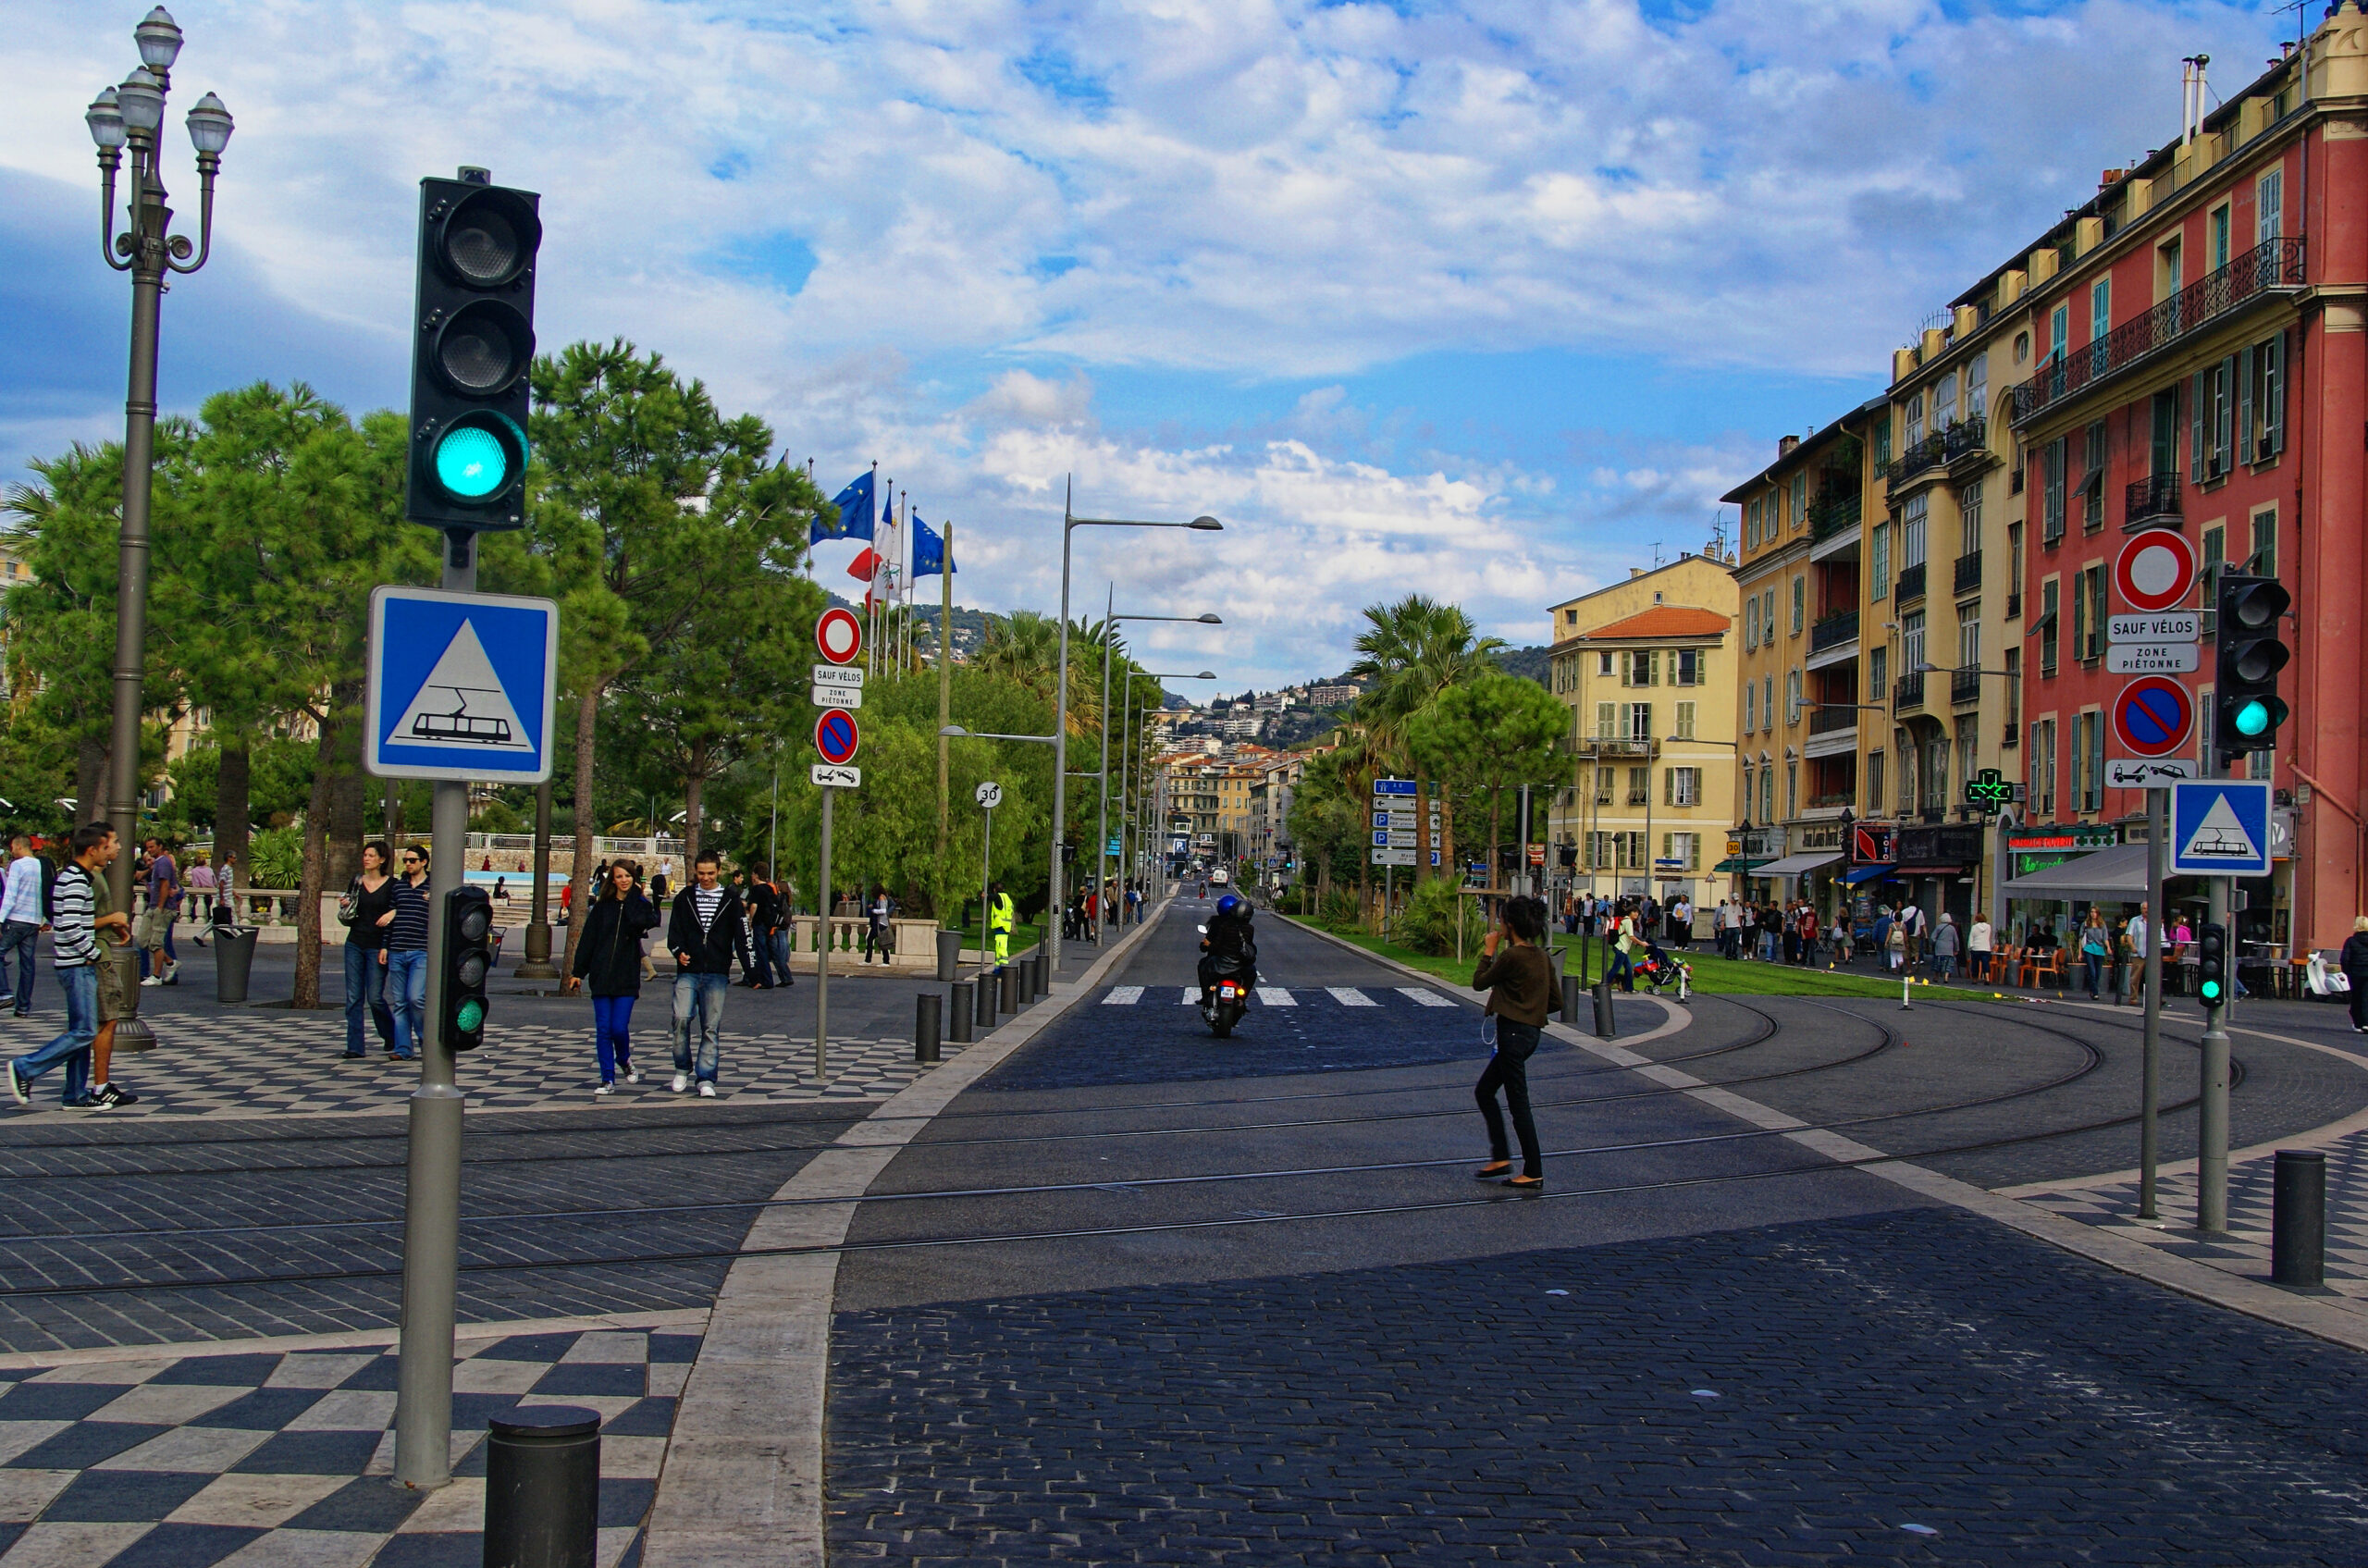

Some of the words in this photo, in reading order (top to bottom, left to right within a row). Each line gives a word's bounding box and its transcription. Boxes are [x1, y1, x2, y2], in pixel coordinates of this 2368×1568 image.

[2114, 622, 2146, 636] SAUF
[2152, 619, 2193, 635] VÉLOS
[2136, 648, 2167, 657] ZONE
[2122, 658, 2182, 669] PIÉTONNE
[818, 671, 836, 680] SAUF
[839, 671, 861, 682] VÉLOS
[821, 697, 854, 705] PIÉTONNE
[981, 790, 997, 800] 30
